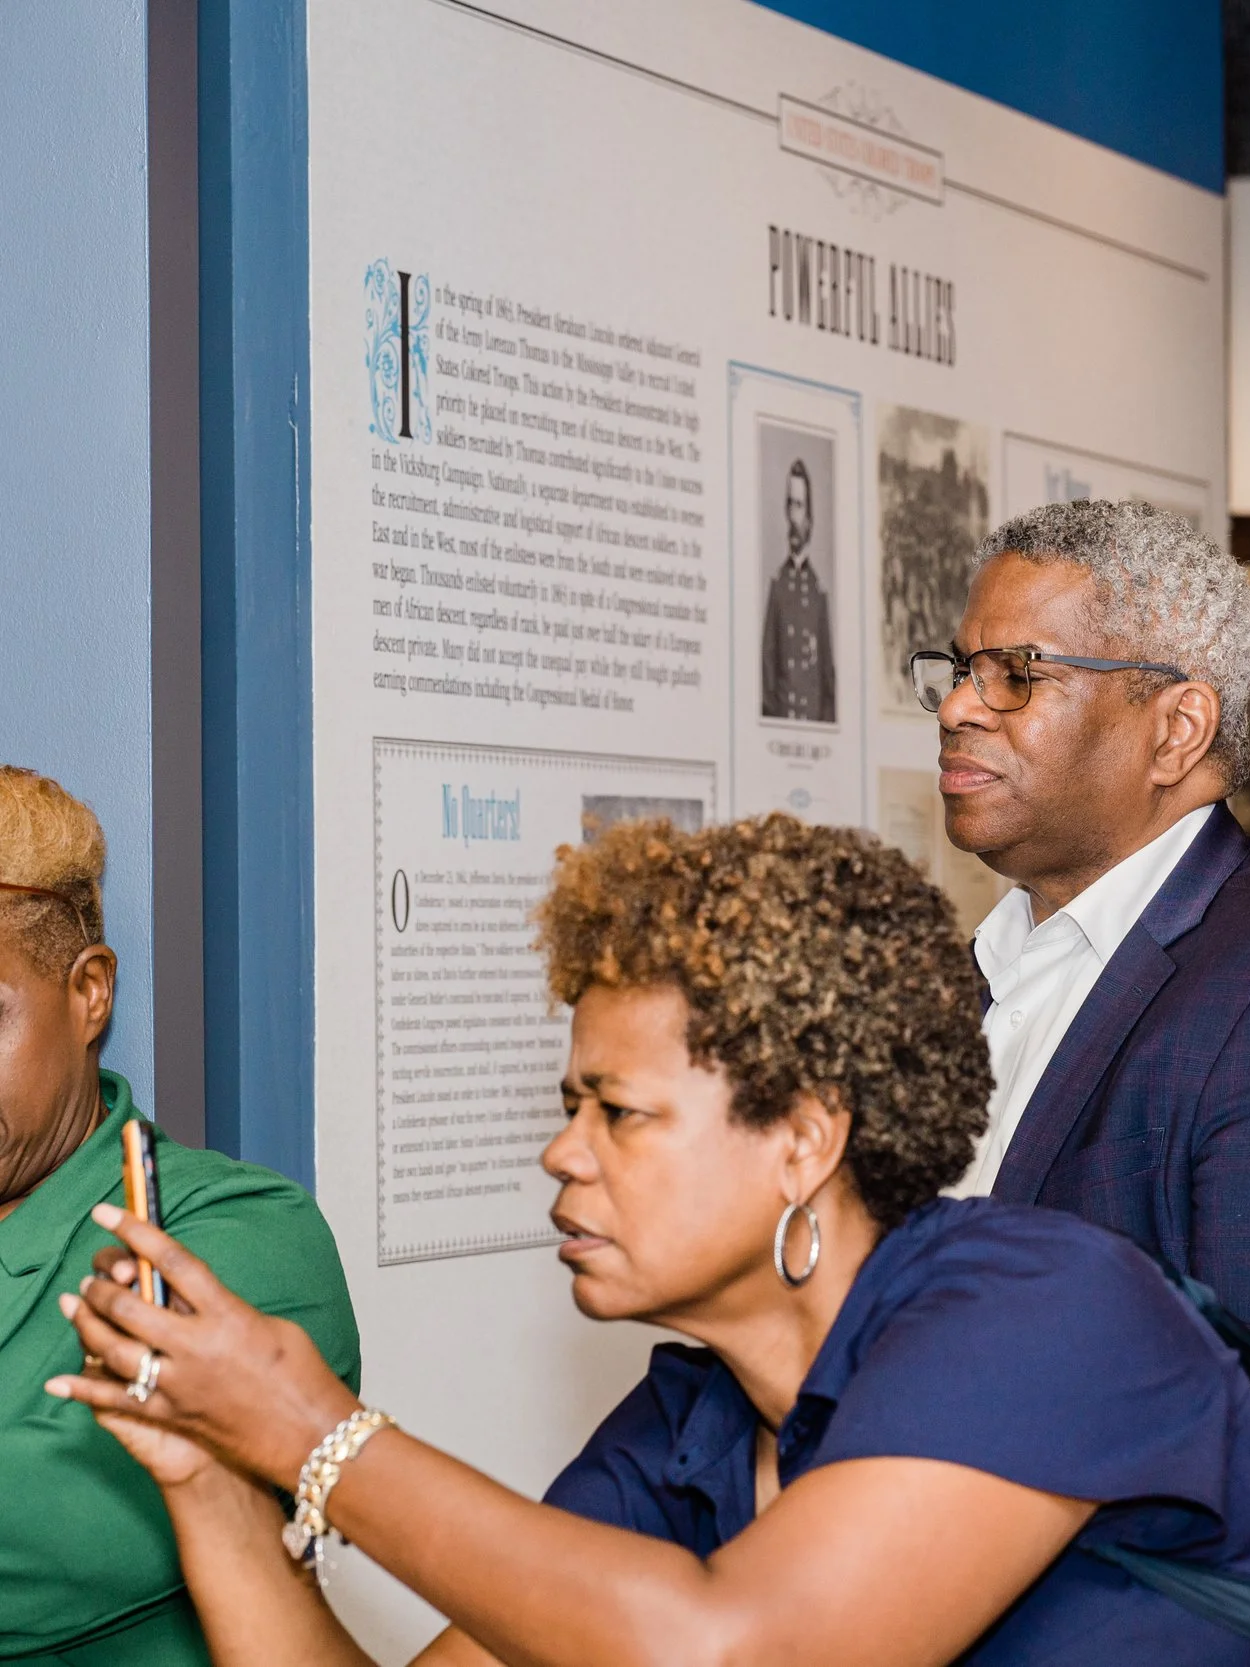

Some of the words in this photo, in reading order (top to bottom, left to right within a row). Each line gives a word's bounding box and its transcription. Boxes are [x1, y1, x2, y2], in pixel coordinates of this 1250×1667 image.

[443, 283, 455, 307] the
[458, 293, 483, 320] spring
[485, 294, 492, 317] of
[516, 303, 550, 331] President
[768, 224, 879, 346] POWERFUL
[888, 262, 955, 367] ALLIES
[435, 317, 444, 340] of
[446, 320, 458, 343] the
[397, 270, 414, 439] I
[436, 353, 459, 379] States
[523, 372, 538, 396] This
[436, 390, 465, 421] priority
[480, 397, 506, 425] placed
[436, 424, 465, 451] soldiers
[468, 436, 503, 458] recruited
[372, 453, 380, 471] in
[383, 448, 396, 473] the
[399, 452, 440, 486] Vicksburg
[372, 482, 384, 507] the
[502, 508, 517, 529] and
[372, 520, 390, 544] East
[392, 524, 408, 547] and
[410, 526, 418, 548] in
[420, 528, 434, 551] the
[459, 540, 478, 557] most
[372, 562, 387, 580] war
[373, 598, 391, 617] men
[393, 594, 402, 619] of
[404, 596, 434, 622] African
[372, 628, 405, 655] descent
[372, 672, 407, 698] earning
[442, 783, 458, 839] No
[462, 784, 521, 848] Quarters!
